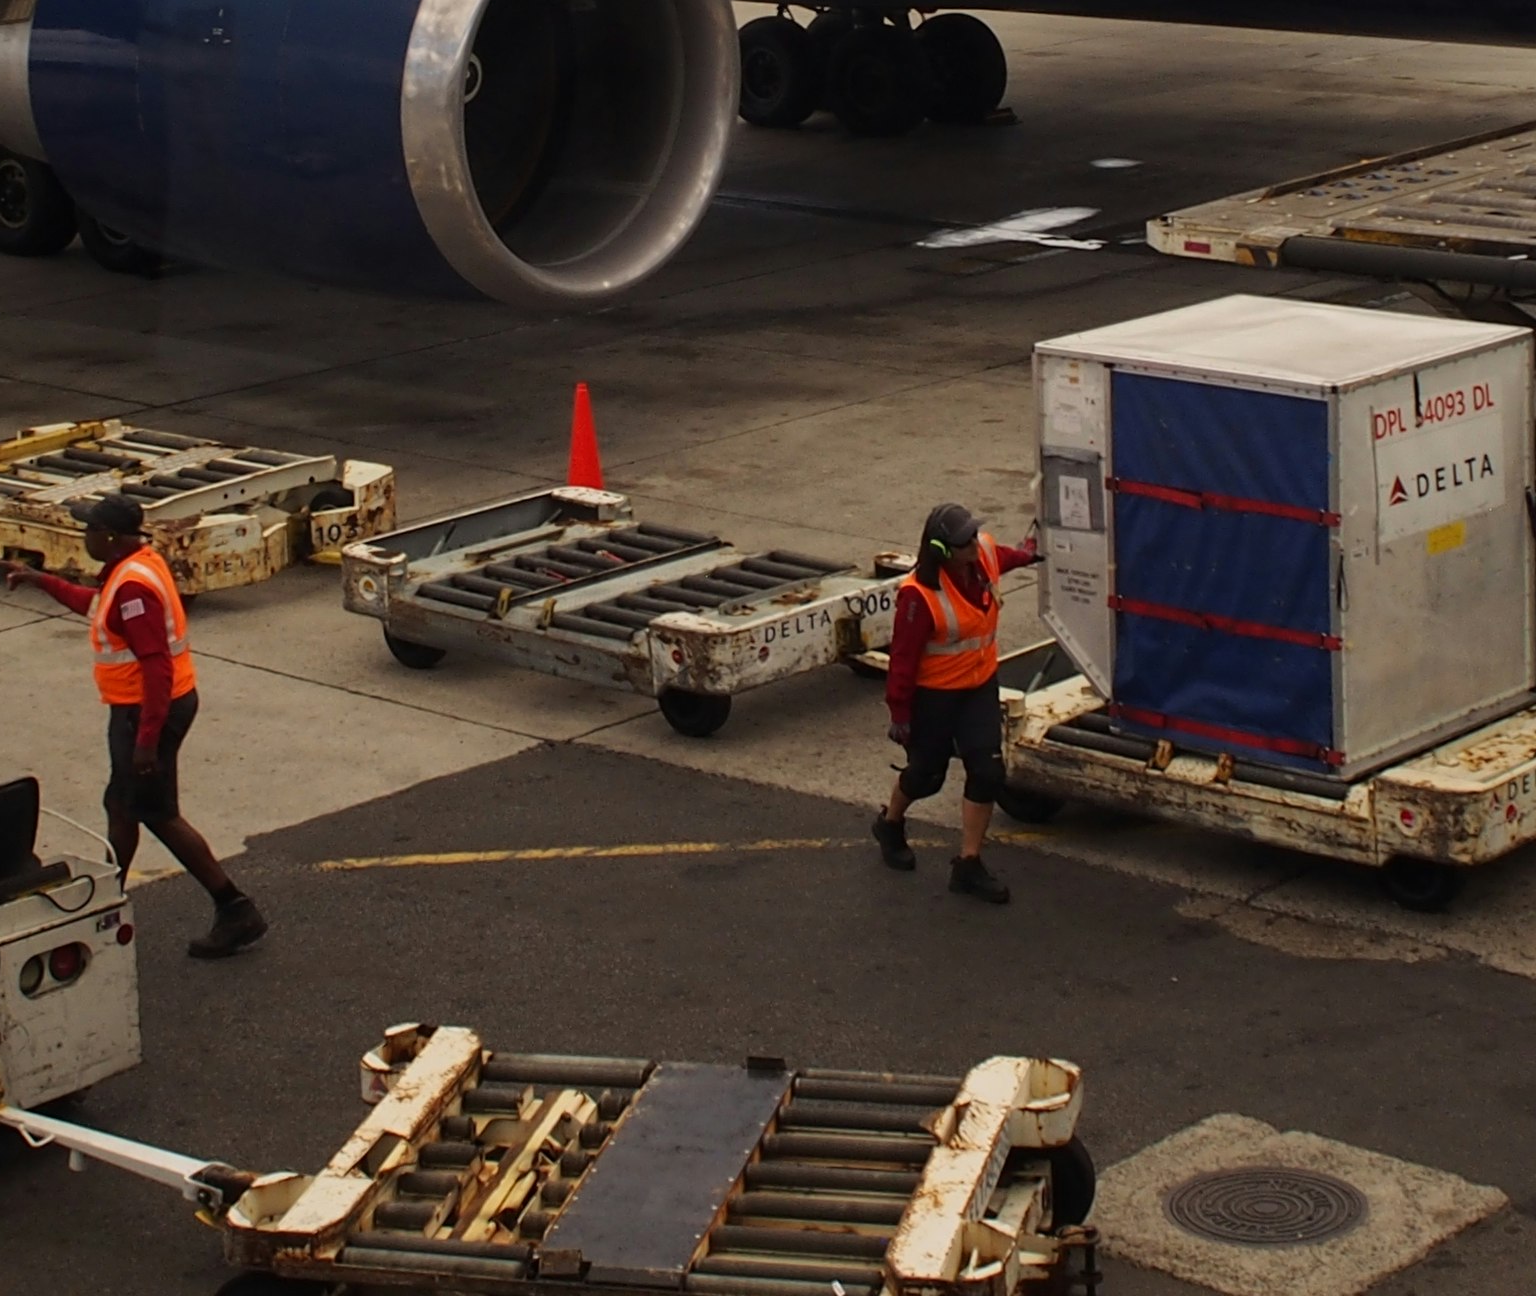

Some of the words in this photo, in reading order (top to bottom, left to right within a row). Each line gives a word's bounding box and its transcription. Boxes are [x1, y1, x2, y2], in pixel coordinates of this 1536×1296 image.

[1374, 408, 1407, 440] DPL
[1472, 382, 1495, 411] DL
[1416, 453, 1494, 498] DELTA
[764, 608, 832, 644] DELTA
